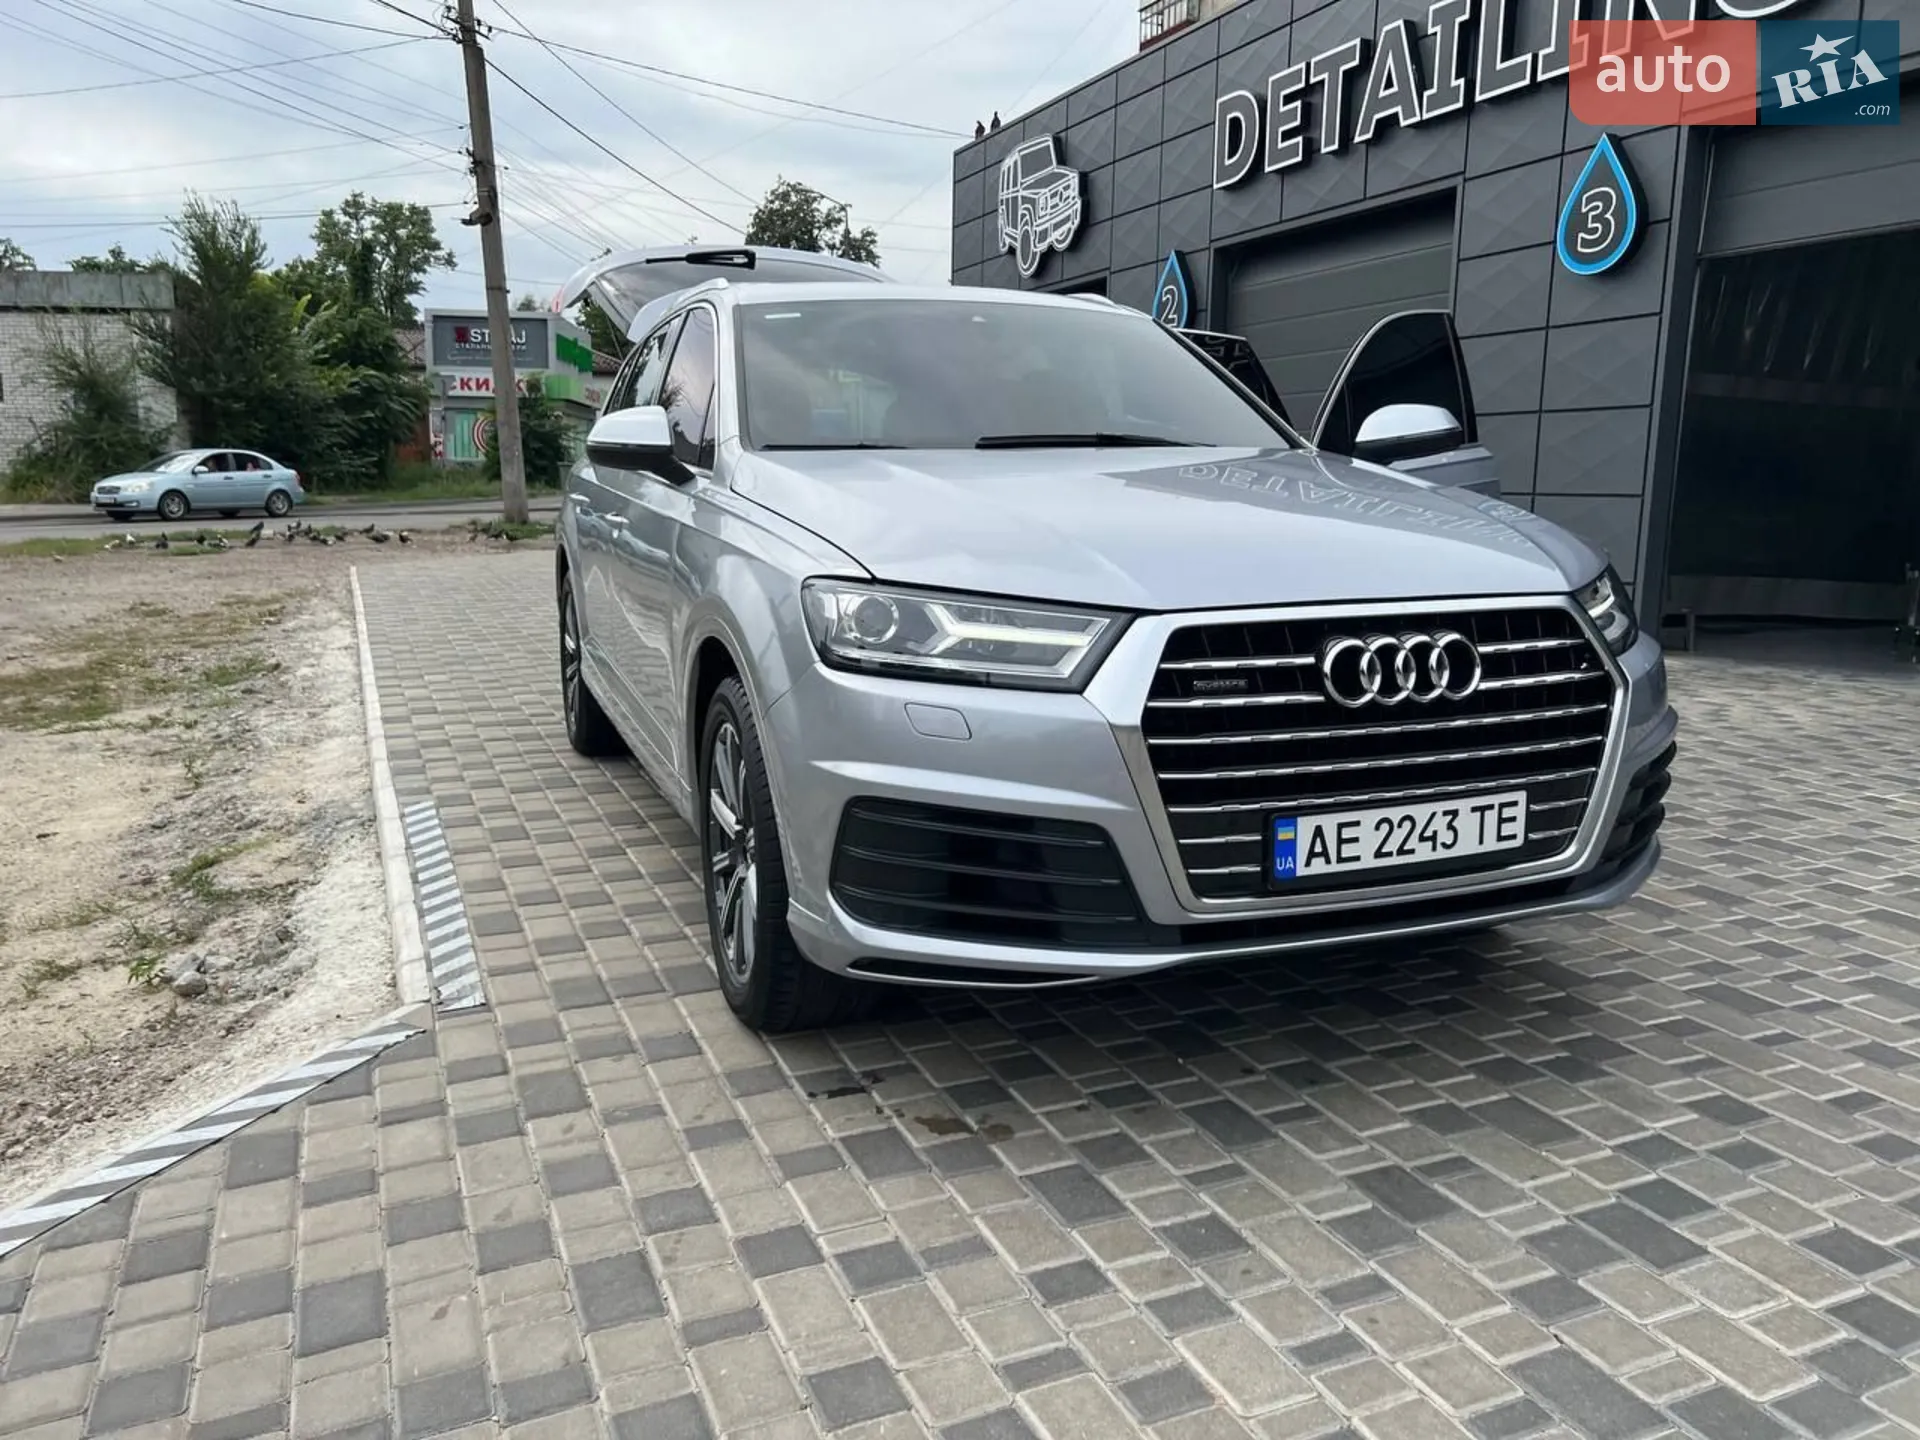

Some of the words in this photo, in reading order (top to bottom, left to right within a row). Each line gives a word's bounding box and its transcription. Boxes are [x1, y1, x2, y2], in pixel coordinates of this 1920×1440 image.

[1577, 187, 1617, 253] 3
[1161, 285, 1178, 327] 2
[1304, 820, 1361, 868] AE
[1373, 808, 1460, 860] 2243
[1470, 800, 1519, 846] TE
[1276, 857, 1295, 871] UA
